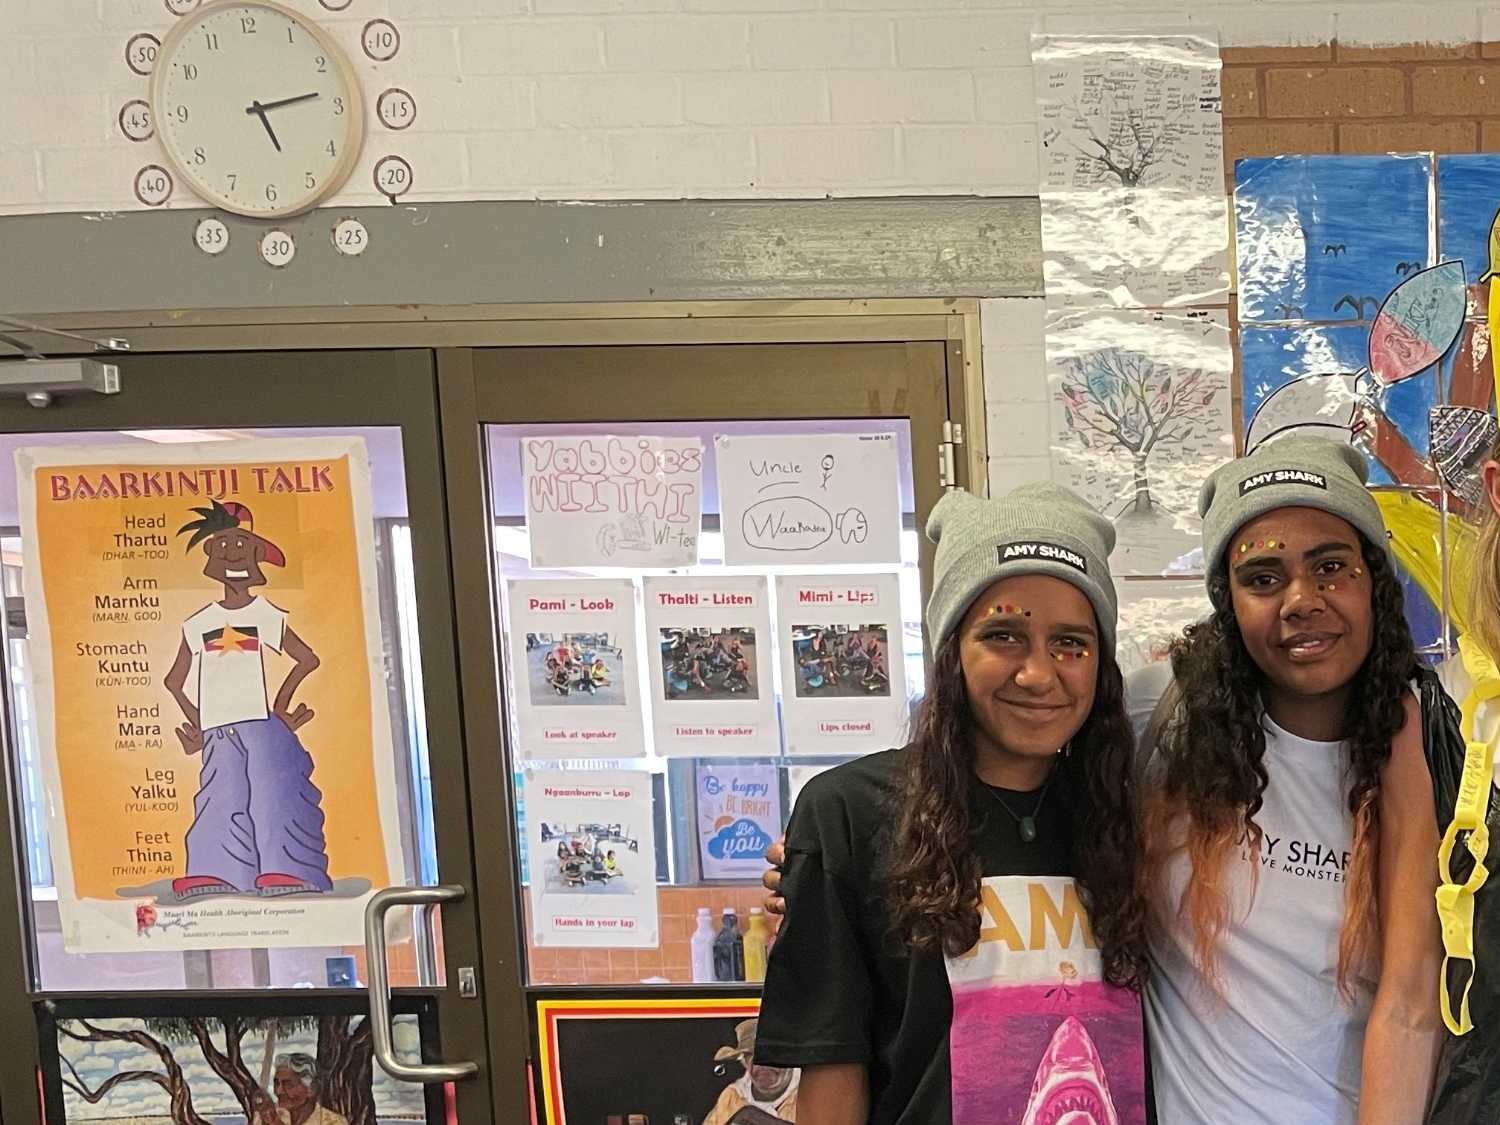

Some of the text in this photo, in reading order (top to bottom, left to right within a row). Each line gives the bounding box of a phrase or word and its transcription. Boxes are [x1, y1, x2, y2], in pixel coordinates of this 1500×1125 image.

[240, 17, 257, 34] 12
[206, 33, 218, 50] 11
[287, 27, 294, 43] 1
[183, 64, 198, 80] 10
[316, 57, 327, 73] 2
[177, 105, 189, 122] 9
[333, 98, 344, 115] 3
[326, 140, 337, 157] 4
[194, 149, 206, 165] 8
[227, 175, 237, 192] 7
[305, 172, 316, 189] 5
[265, 185, 277, 201] 6
[529, 440, 700, 474] Yabbies
[750, 460, 802, 476] Uncle
[51, 465, 335, 501] BAARKINTJI TALK
[1243, 471, 1324, 491] AMY SHARK
[125, 515, 166, 529] Head
[113, 533, 168, 547] Thartu
[1003, 545, 1085, 570] AMY SHARK
[123, 576, 158, 590] Arm
[95, 595, 160, 609] Marnku
[713, 592, 753, 606] Listen
[799, 589, 833, 603] Mimi
[529, 597, 614, 611] Pami Look
[76, 641, 147, 656] Stomach
[98, 659, 150, 673] Kuntu
[117, 705, 160, 718] Hand
[118, 723, 161, 736] Mara
[676, 726, 753, 738] Listen to speaker
[820, 722, 871, 733] Lips closed
[545, 730, 617, 742] Look at speaker
[145, 768, 174, 784] Leg
[131, 786, 177, 800] Yalku
[612, 788, 631, 799] Lap
[703, 775, 769, 797] Be happy
[736, 821, 755, 836] Be
[135, 831, 172, 845] Feet
[721, 835, 764, 859] you
[127, 848, 172, 862] Thina
[555, 918, 635, 930] Hands in your lap
